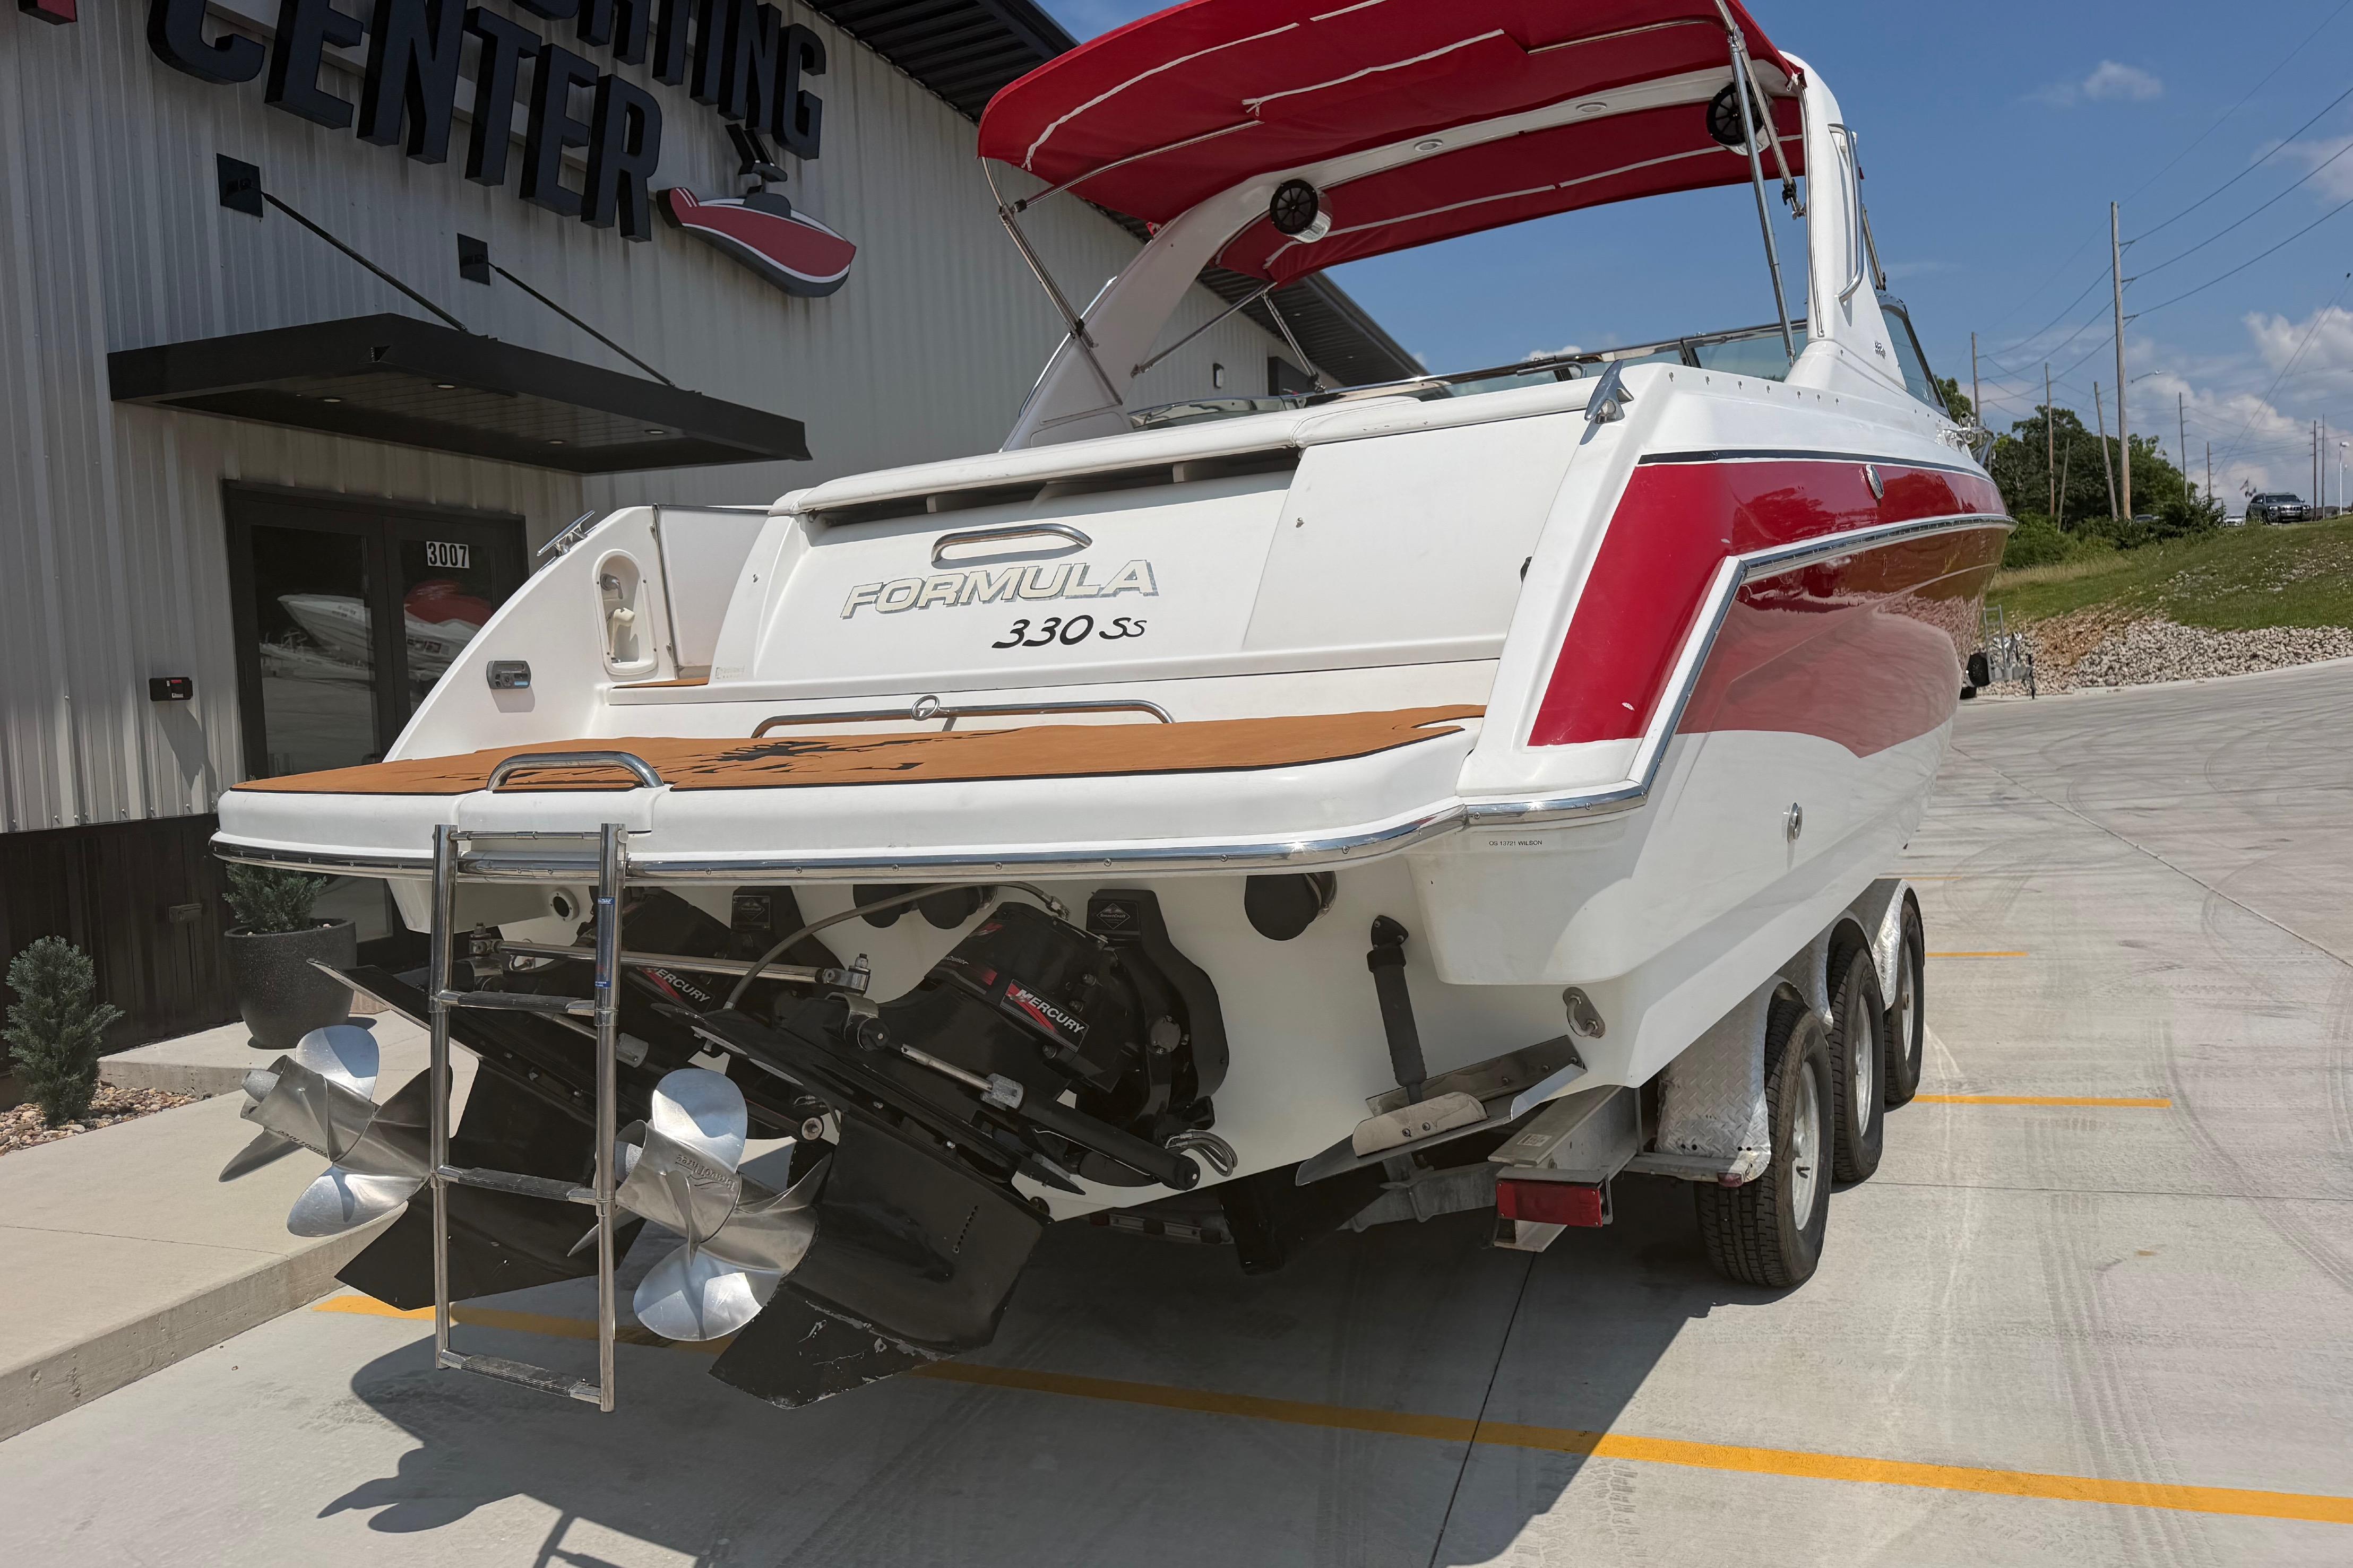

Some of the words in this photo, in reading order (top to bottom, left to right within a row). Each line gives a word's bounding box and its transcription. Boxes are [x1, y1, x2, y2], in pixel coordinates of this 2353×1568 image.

[428, 542, 467, 567] 3007
[840, 560, 1159, 620] FORMULA
[992, 614, 1094, 648] 330
[1015, 989, 1085, 1034] MERCURY
